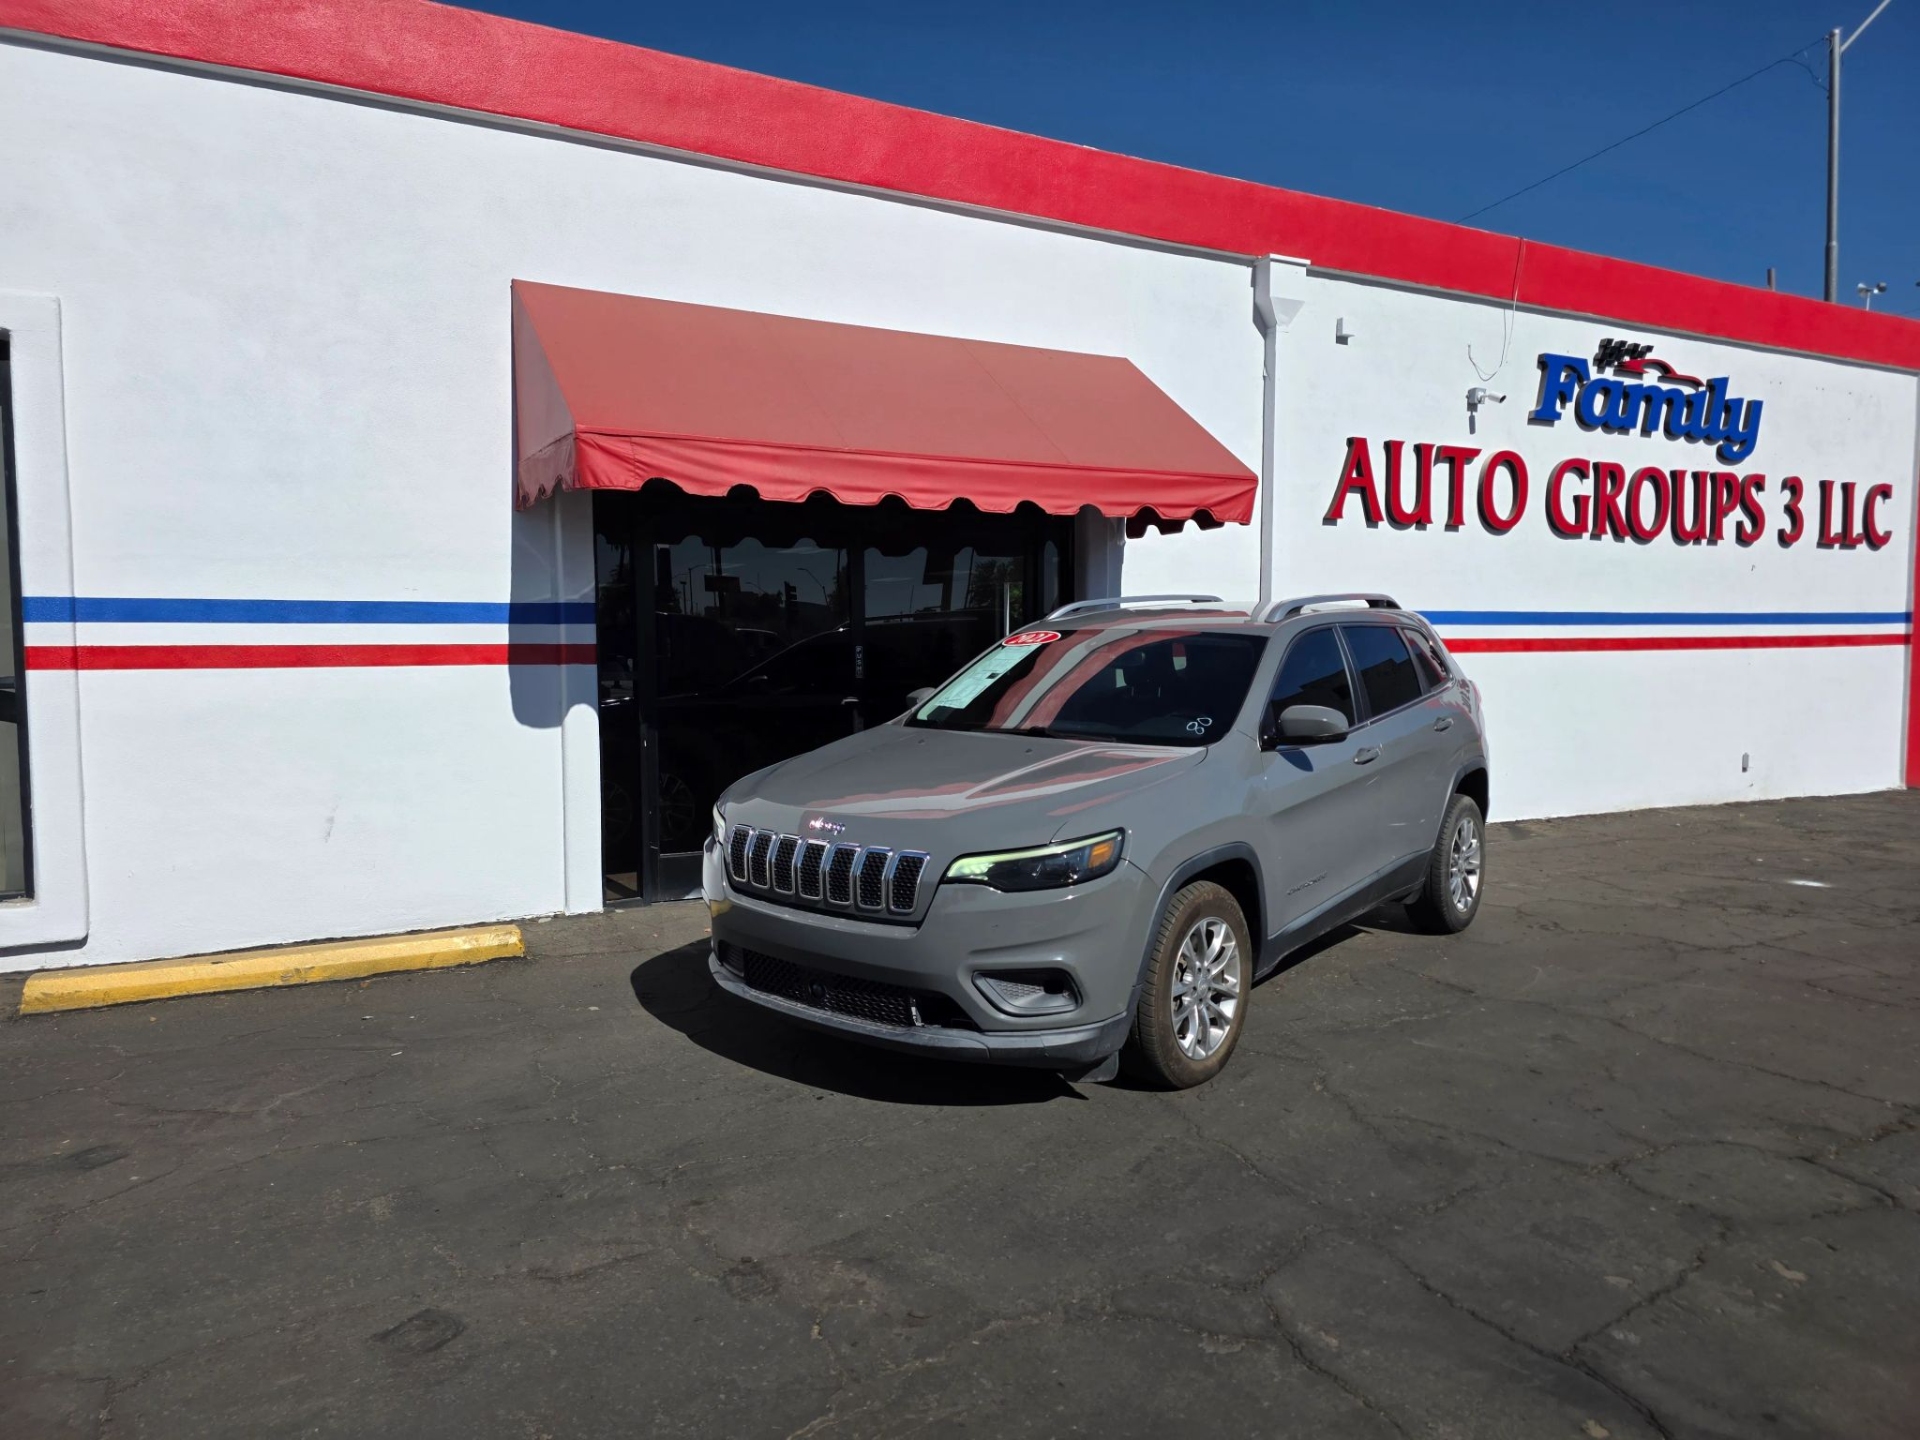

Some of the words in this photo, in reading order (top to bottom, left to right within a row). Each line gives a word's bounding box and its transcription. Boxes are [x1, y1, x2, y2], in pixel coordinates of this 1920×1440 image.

[1528, 353, 1764, 462] Family
[1323, 437, 1528, 533] AUTO
[1546, 457, 1766, 545] GROUPS
[1778, 476, 1804, 547] 3
[1817, 480, 1893, 550] LLC
